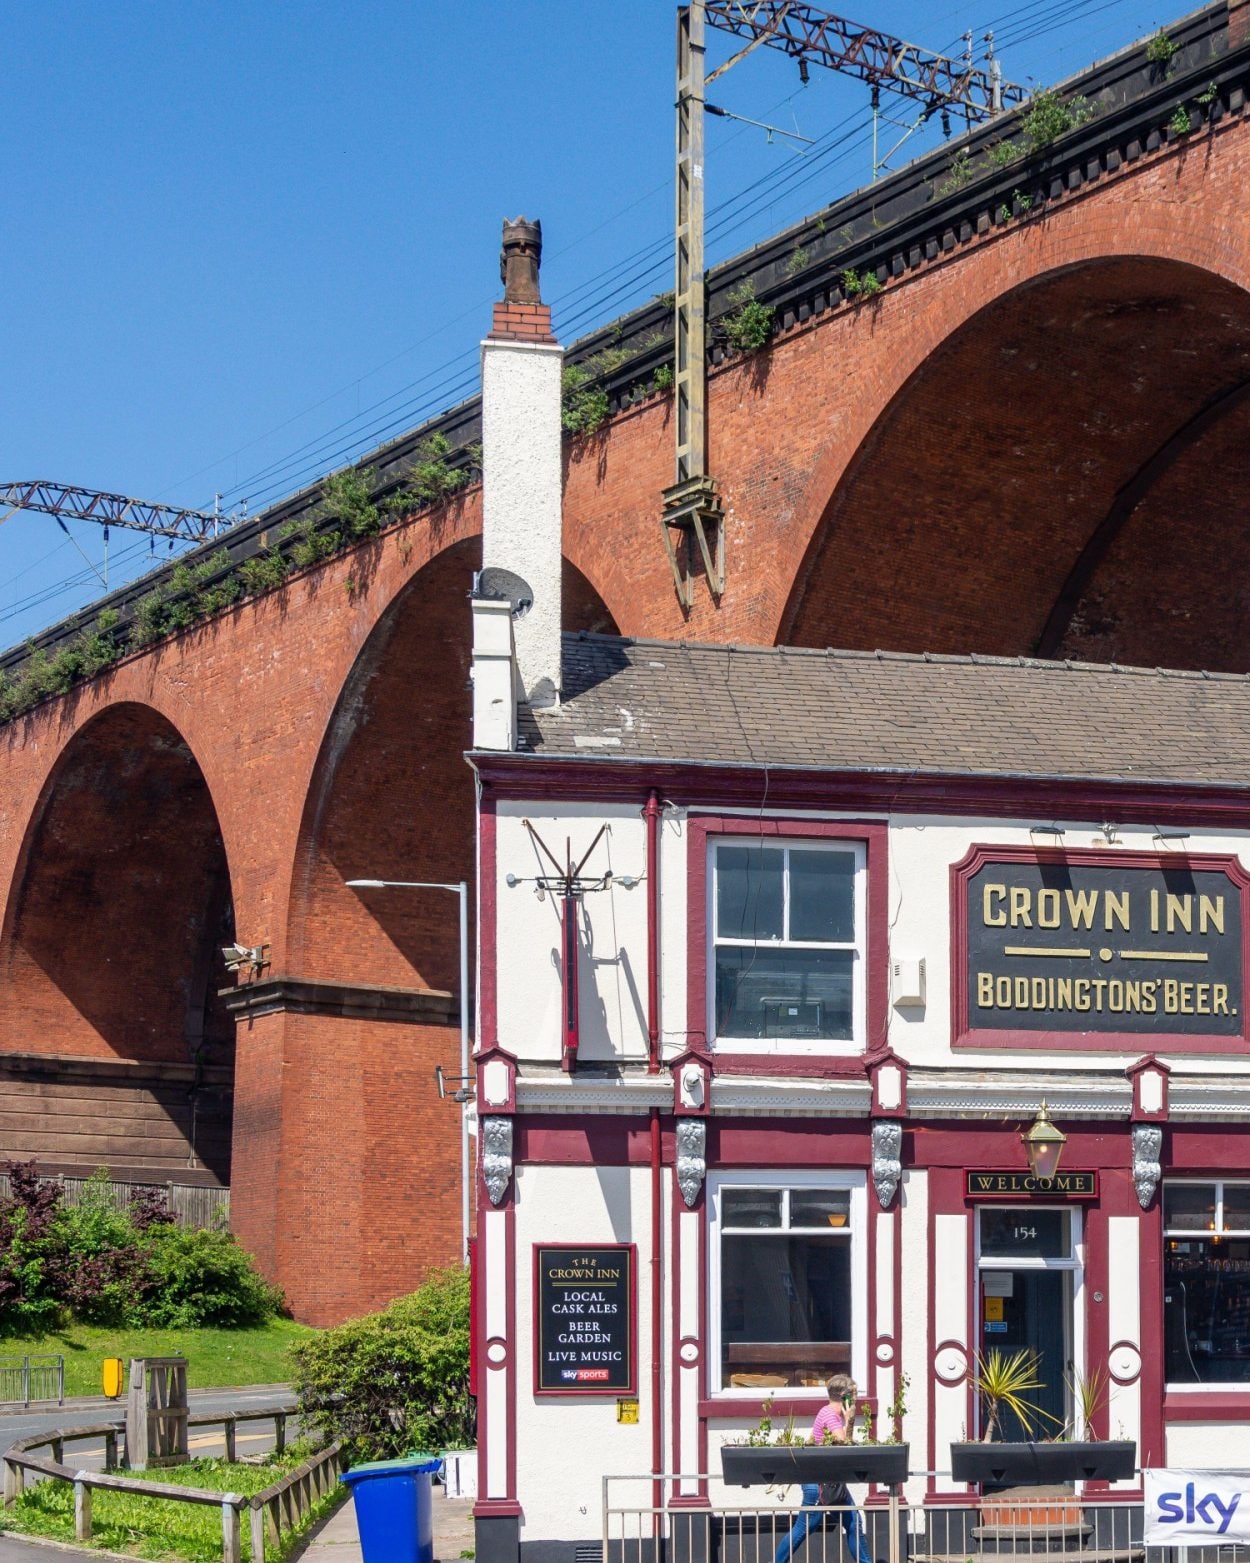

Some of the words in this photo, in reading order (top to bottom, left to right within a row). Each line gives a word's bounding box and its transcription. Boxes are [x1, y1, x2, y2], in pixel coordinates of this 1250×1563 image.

[983, 883, 1130, 931] CROWN
[1150, 887, 1225, 934] INN
[977, 1176, 1085, 1190] WELCOME
[1014, 1227, 1037, 1239] 154
[572, 1257, 597, 1267] THE
[549, 1269, 594, 1279] CROWN
[597, 1269, 620, 1278] INN
[564, 1292, 605, 1302] LOCAL
[552, 1304, 584, 1314] CASK
[588, 1304, 618, 1314] ALES
[569, 1322, 600, 1331] BEER
[558, 1333, 611, 1343] GARDEN
[548, 1352, 577, 1361] LIVE
[581, 1351, 622, 1361] MUSIC
[563, 1370, 577, 1380] sky
[579, 1371, 608, 1380] sports
[1157, 1482, 1241, 1533] sky
